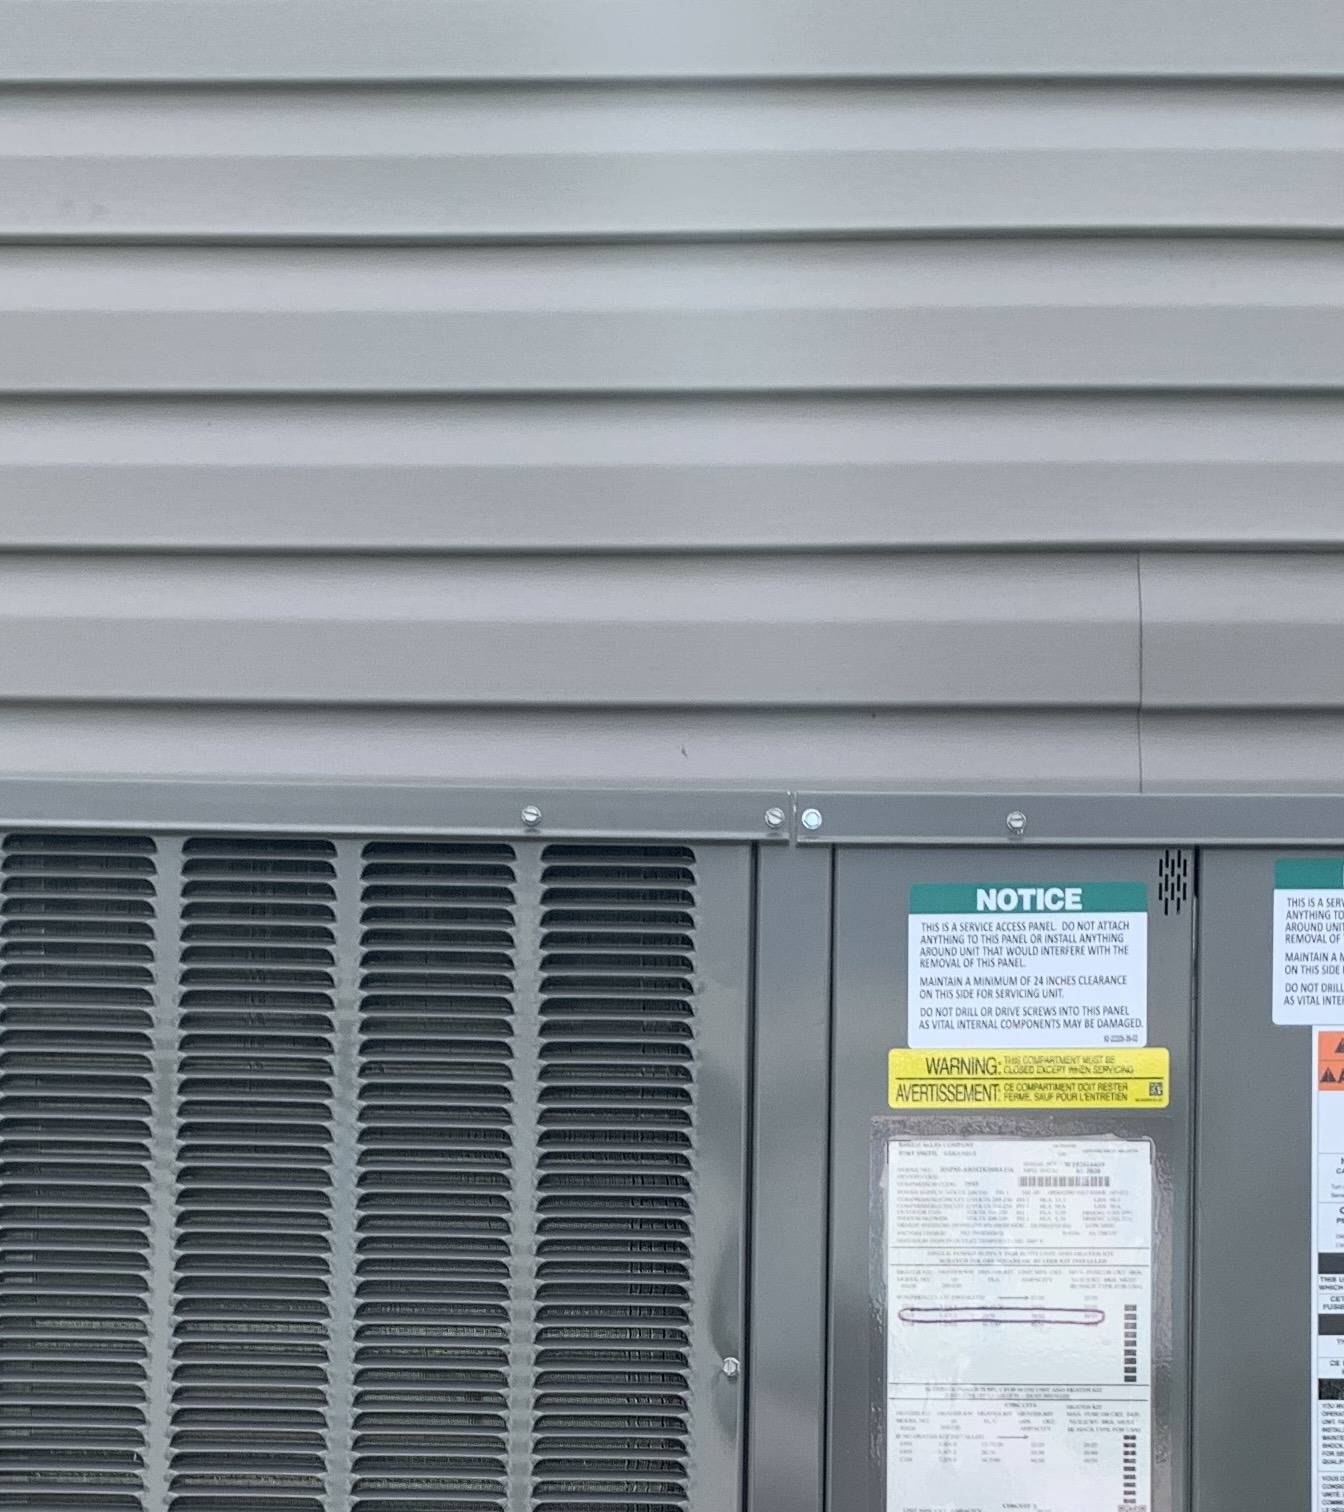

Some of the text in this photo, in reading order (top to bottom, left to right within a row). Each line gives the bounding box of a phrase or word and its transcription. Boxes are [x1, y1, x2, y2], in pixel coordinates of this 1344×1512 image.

[976, 888, 1082, 911] NOTICE
[1287, 898, 1305, 908] THIS
[1307, 898, 1315, 908] IS
[1317, 898, 1323, 908] A
[1286, 911, 1331, 920] ANYTHING
[1334, 911, 1344, 920] TO
[921, 921, 1129, 932] THIS IS A SERVICE ACCESS PANEL. DO NOT ATTACH
[1285, 922, 1323, 932] AROUND
[920, 933, 1123, 944] ANYTHING TO THIS PANEL OR INSTALL ANYTHING
[1285, 934, 1326, 944] REMOVAL
[1328, 934, 1340, 944] OF
[920, 945, 1129, 956] AROUND UNIT THAT WOULD INTERFERE WITH THE
[920, 958, 1026, 968] REMOVAL OF THIS PANEL.
[1285, 953, 1328, 962] MAINTAIN
[1330, 953, 1337, 962] A
[1285, 965, 1298, 974] ON
[1301, 965, 1319, 974] THIS
[1321, 965, 1339, 974] SIDE
[919, 975, 1127, 986] MAINTAIN A MINIMUM OF 24 INCHES CLEARANCE
[1285, 983, 1298, 992] DO
[1300, 983, 1318, 992] NOT
[1320, 983, 1343, 992] DRILL
[919, 988, 1064, 999] ON THIS SIDE FOR SERVICING UNIT.
[1284, 996, 1294, 1005] AS
[1296, 996, 1319, 1005] VITAL
[920, 1006, 1129, 1017] DO NOT DRILL OR DRIVE SCREWS INTO THIS PANEL
[919, 1018, 1143, 1030] AS VITAL INTERNAL COMPONENTS MAY BE DAMAGED.
[926, 1057, 1001, 1076] WARNING:
[896, 1084, 1001, 1102] AVERTISSEMENT:
